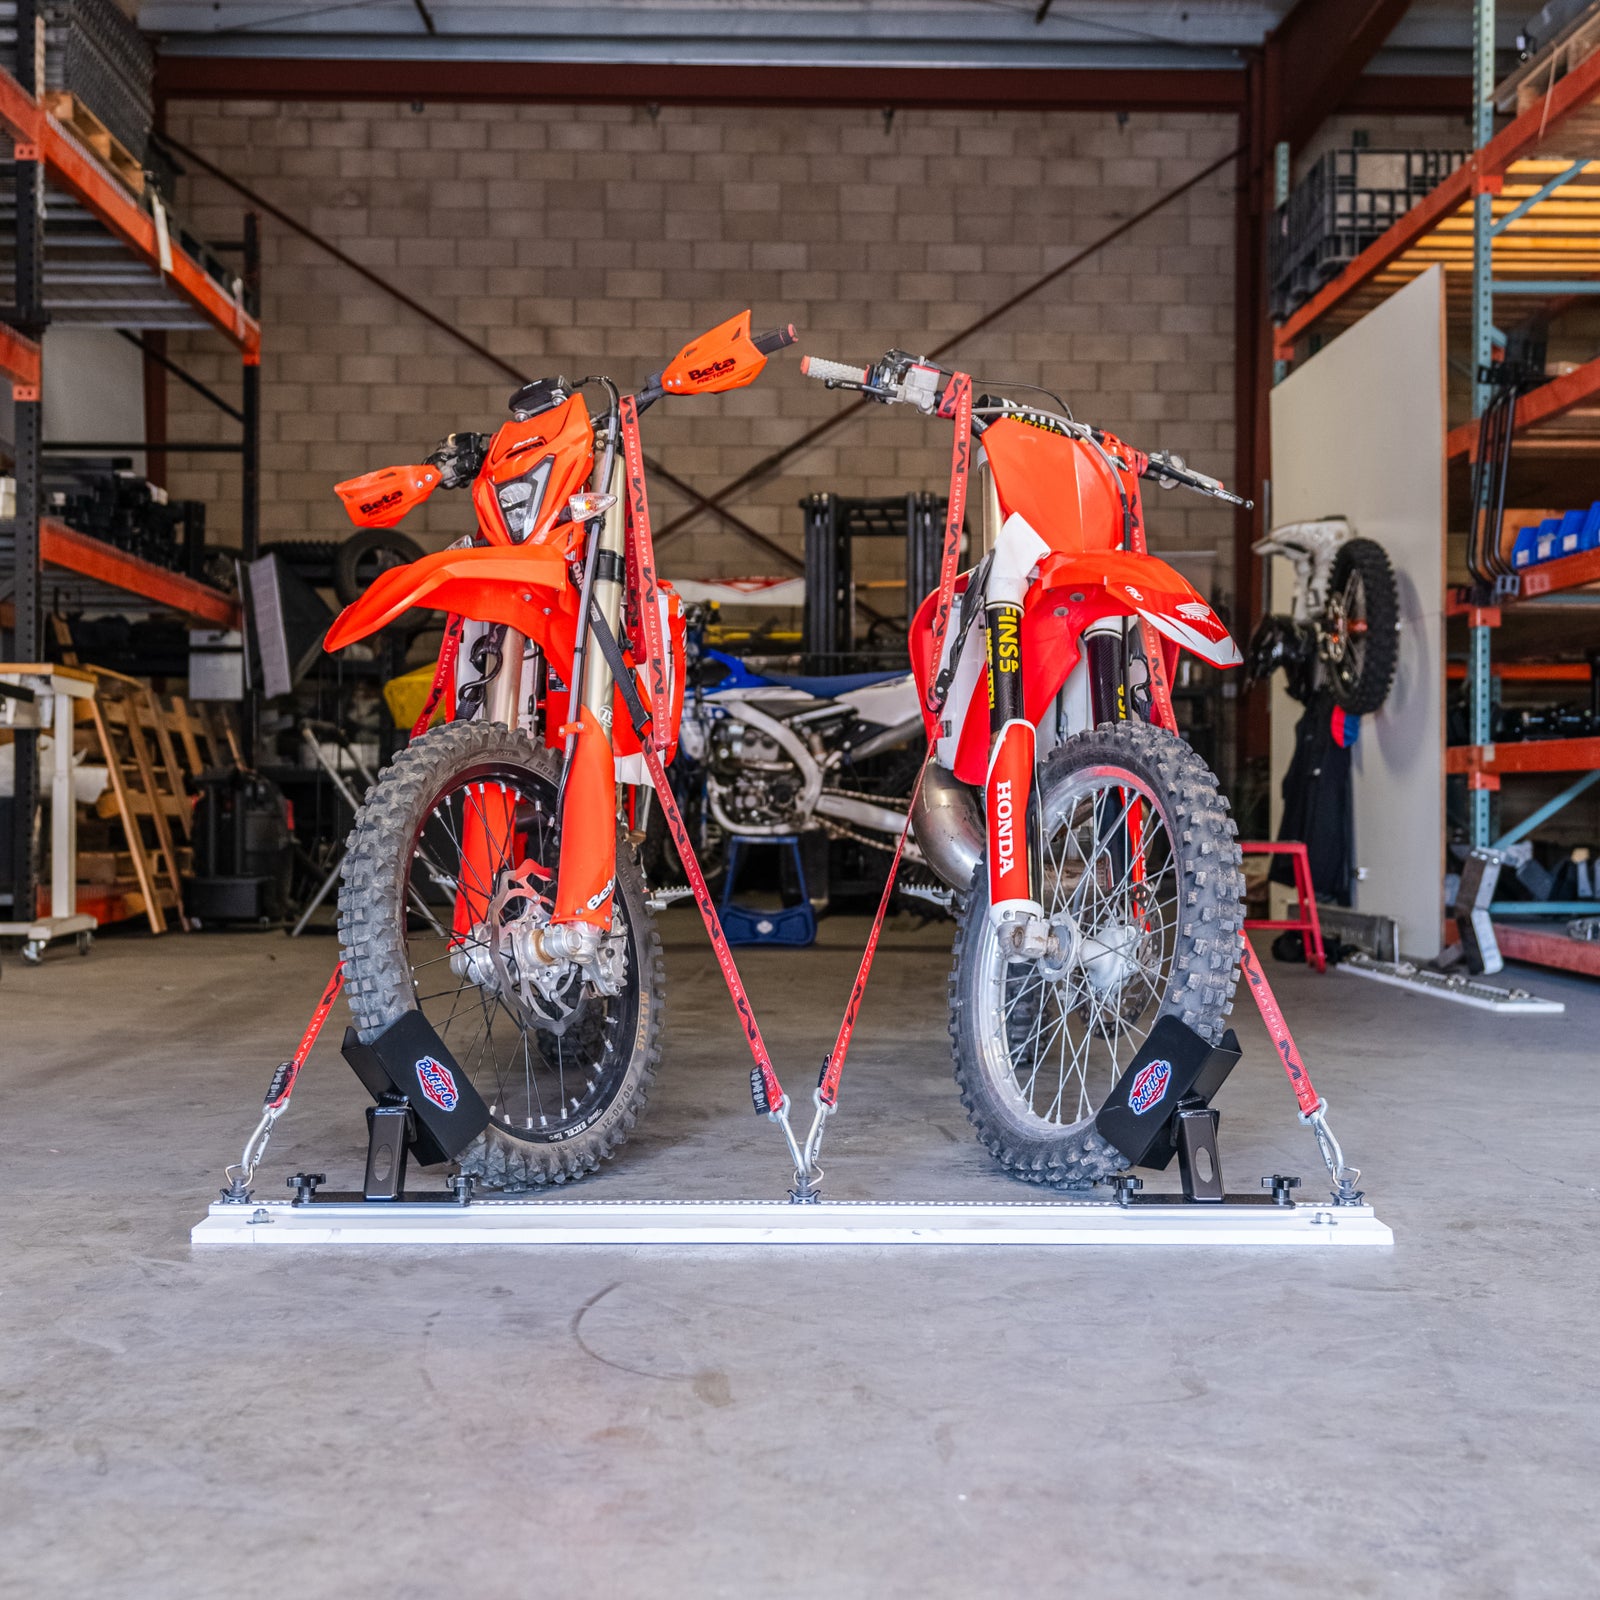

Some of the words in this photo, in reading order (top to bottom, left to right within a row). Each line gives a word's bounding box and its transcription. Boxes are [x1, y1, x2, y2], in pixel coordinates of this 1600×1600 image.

[688, 358, 736, 381] Beta
[960, 393, 968, 440] MATRIX
[360, 490, 403, 515] Beta
[953, 476, 963, 522] MATRIX
[627, 427, 639, 476] MATRIX
[638, 515, 649, 565] MATRIX
[648, 606, 659, 657] MATRIX
[942, 558, 953, 604] MATRIX
[438, 639, 454, 687] MATRIX
[997, 780, 1014, 878] HONDA
[587, 874, 615, 910] Bet
[650, 757, 671, 807] MATRIX
[683, 847, 705, 899] MATRIX
[716, 941, 740, 998] MATRIX
[297, 1009, 325, 1062] MATRIX
[636, 990, 649, 1052] MAXXIS
[1256, 986, 1283, 1039] MATRIX
[418, 1060, 441, 1083] Bolt
[1131, 1085, 1152, 1112] Bolt
[1154, 1063, 1169, 1079] On
[564, 1120, 588, 1137] EXCEL
[601, 1083, 634, 1130] 90/90-21
